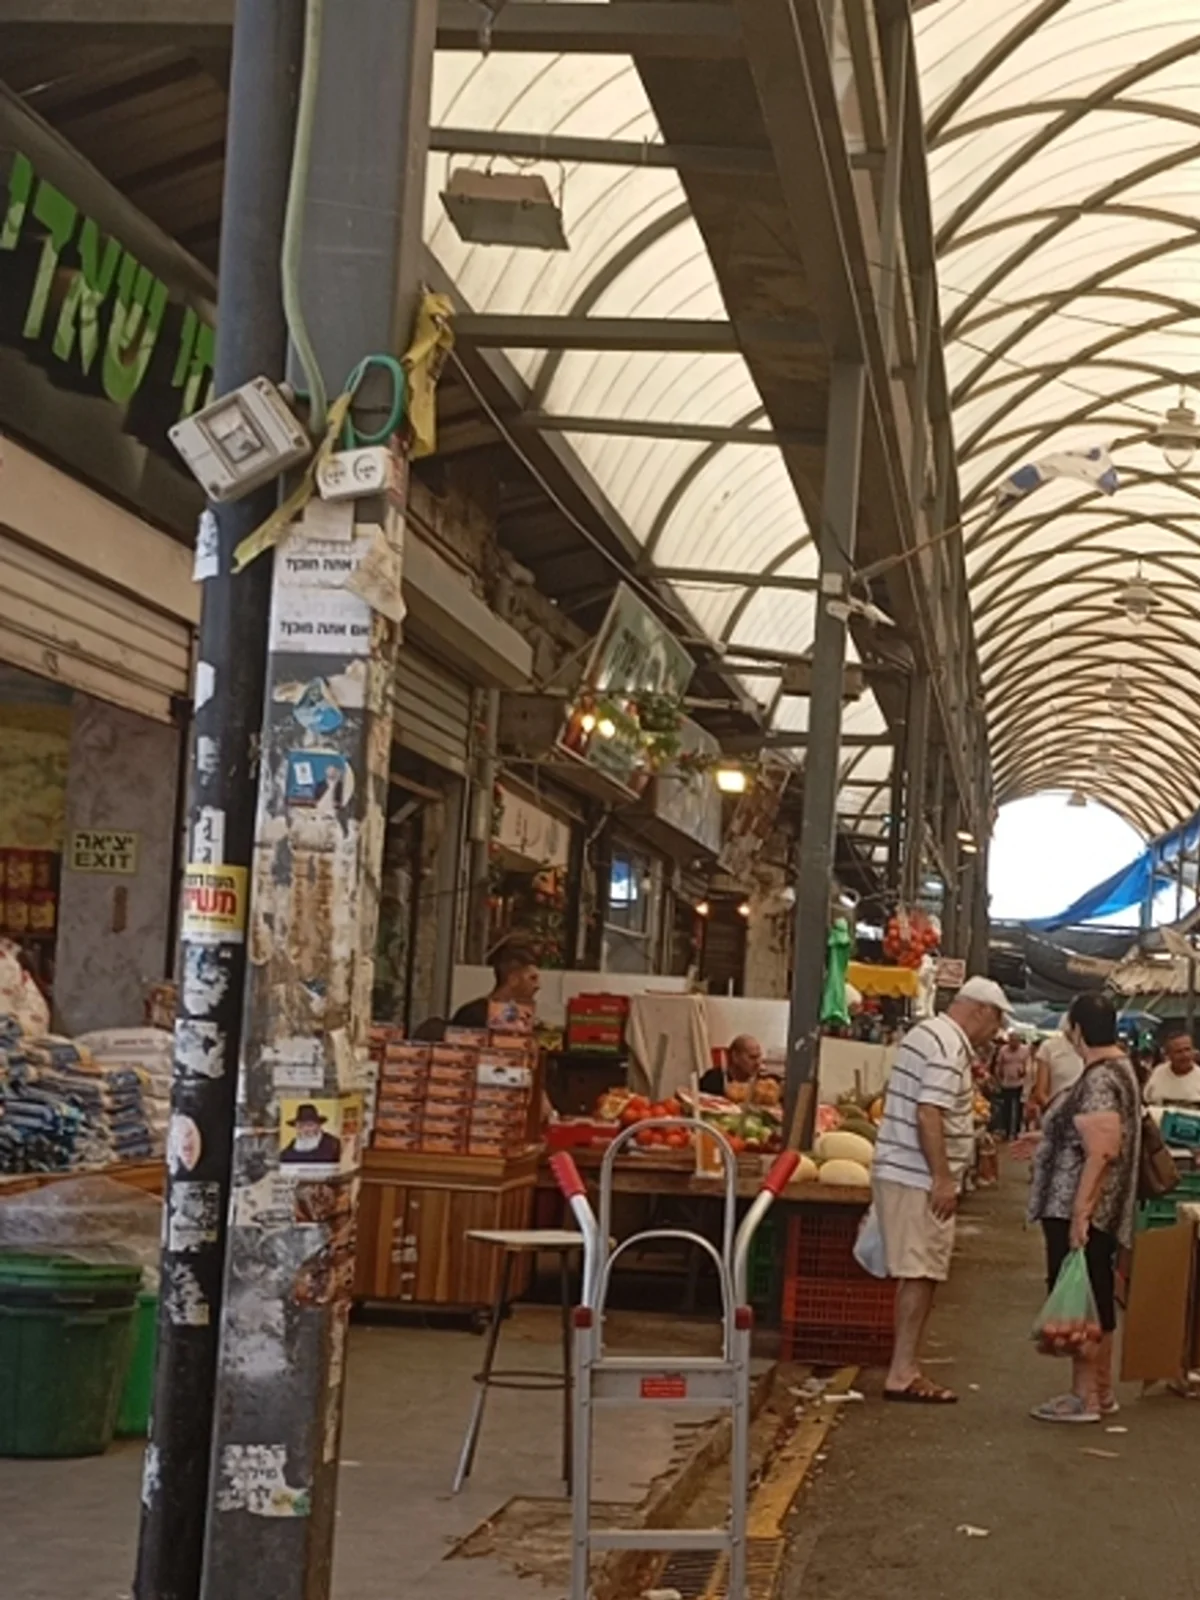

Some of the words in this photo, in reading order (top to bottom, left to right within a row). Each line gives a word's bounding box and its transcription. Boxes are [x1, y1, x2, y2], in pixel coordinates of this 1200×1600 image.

[316, 622, 347, 636] אתה
[75, 832, 133, 851] יציאה
[75, 852, 132, 869] EXIT
